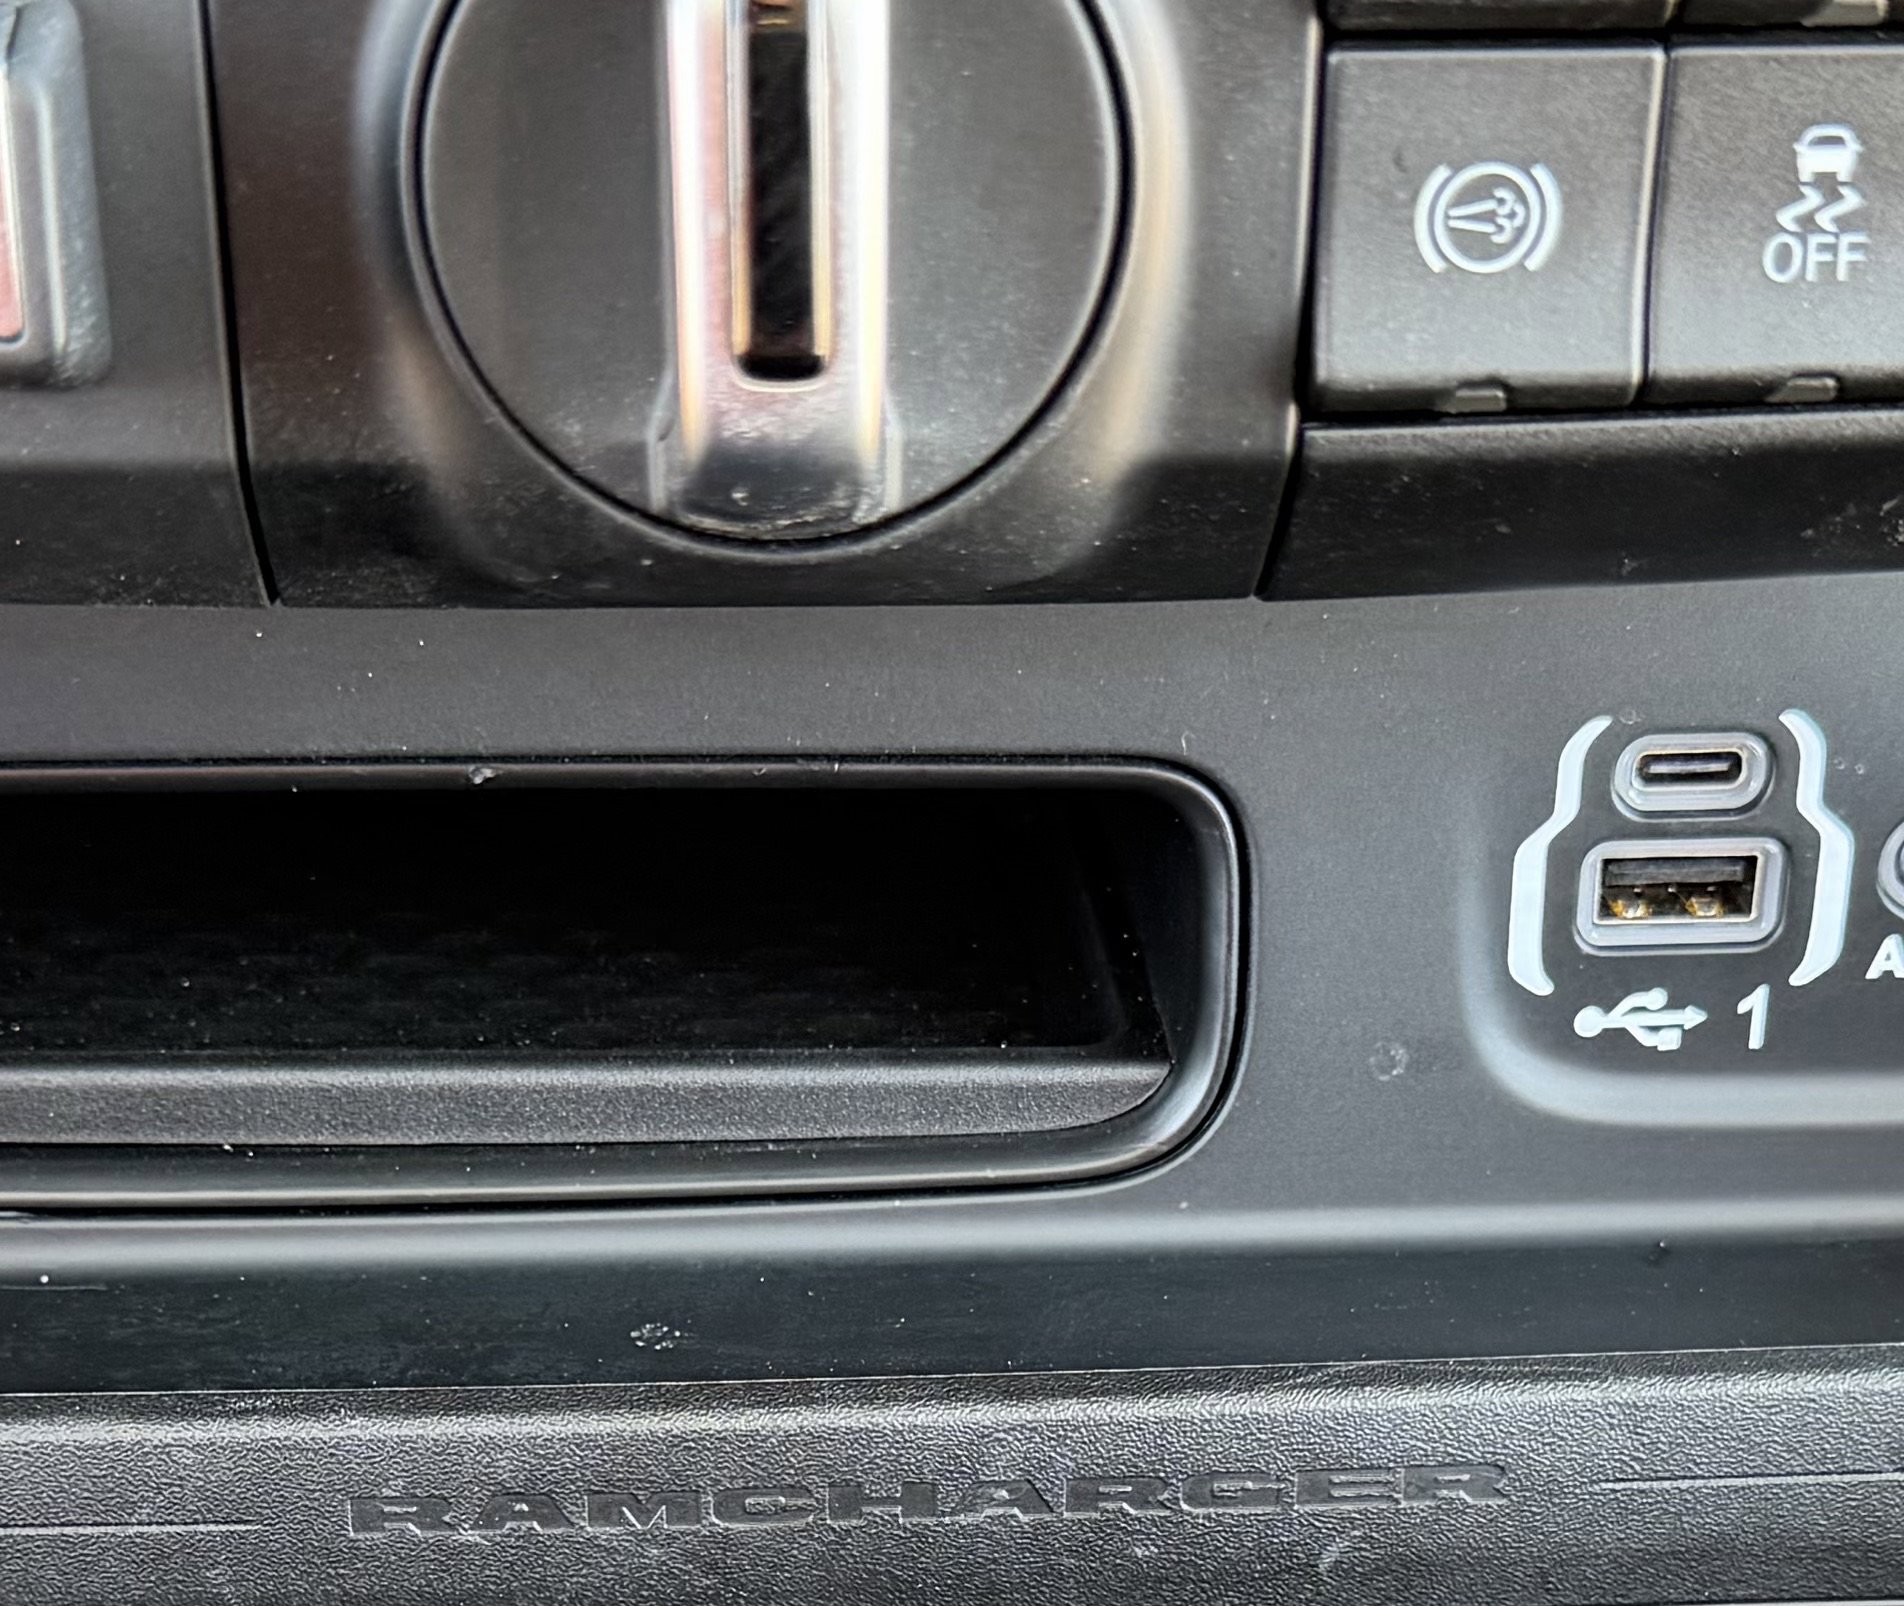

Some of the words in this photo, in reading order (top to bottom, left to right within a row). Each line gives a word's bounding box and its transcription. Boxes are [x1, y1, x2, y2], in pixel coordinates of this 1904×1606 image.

[1761, 232, 1870, 284] OFF
[1736, 984, 1771, 1050] 1
[348, 1463, 1509, 1537] RAMCHARGER
